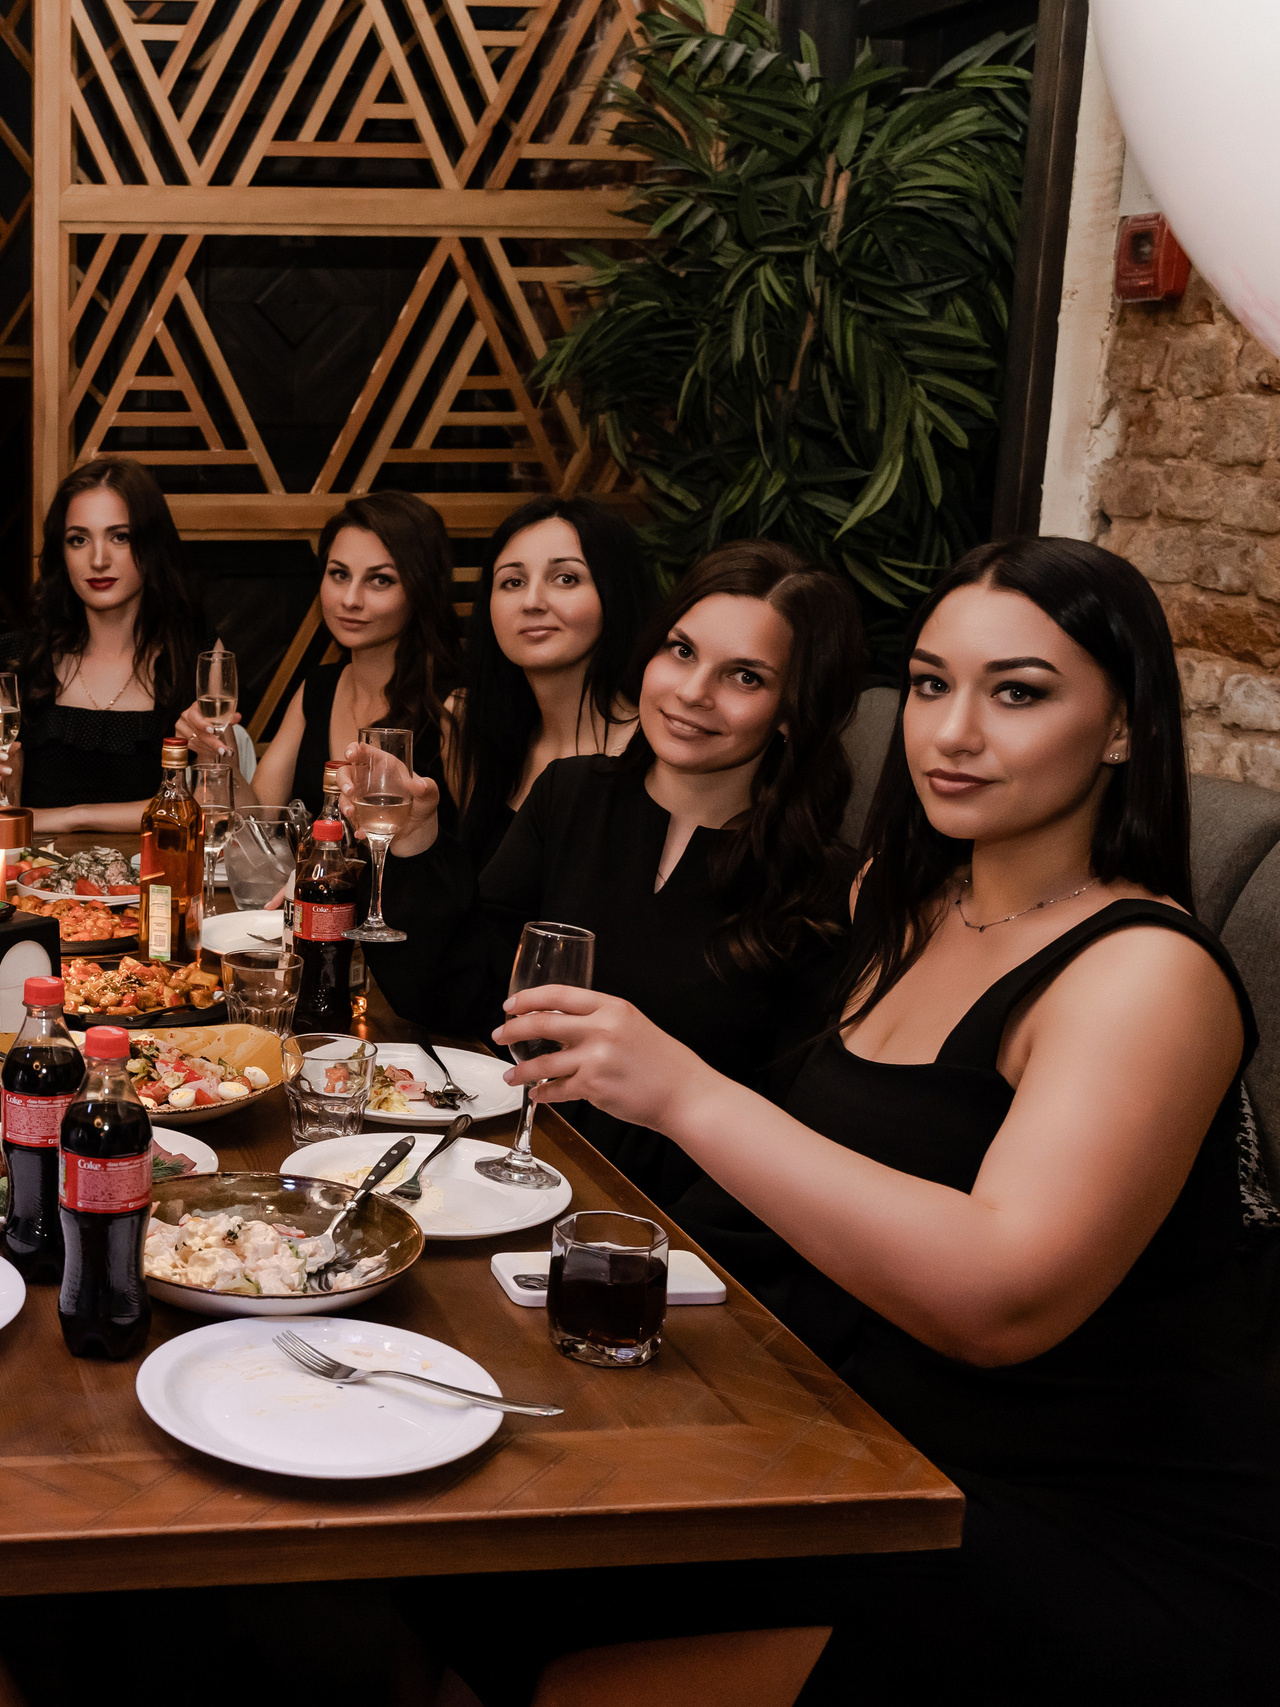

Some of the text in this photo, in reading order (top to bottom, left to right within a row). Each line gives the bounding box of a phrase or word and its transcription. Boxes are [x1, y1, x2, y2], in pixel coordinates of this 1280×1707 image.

[312, 905, 329, 913] Coke
[6, 1093, 23, 1106] Coke
[77, 1158, 101, 1171] Coke
